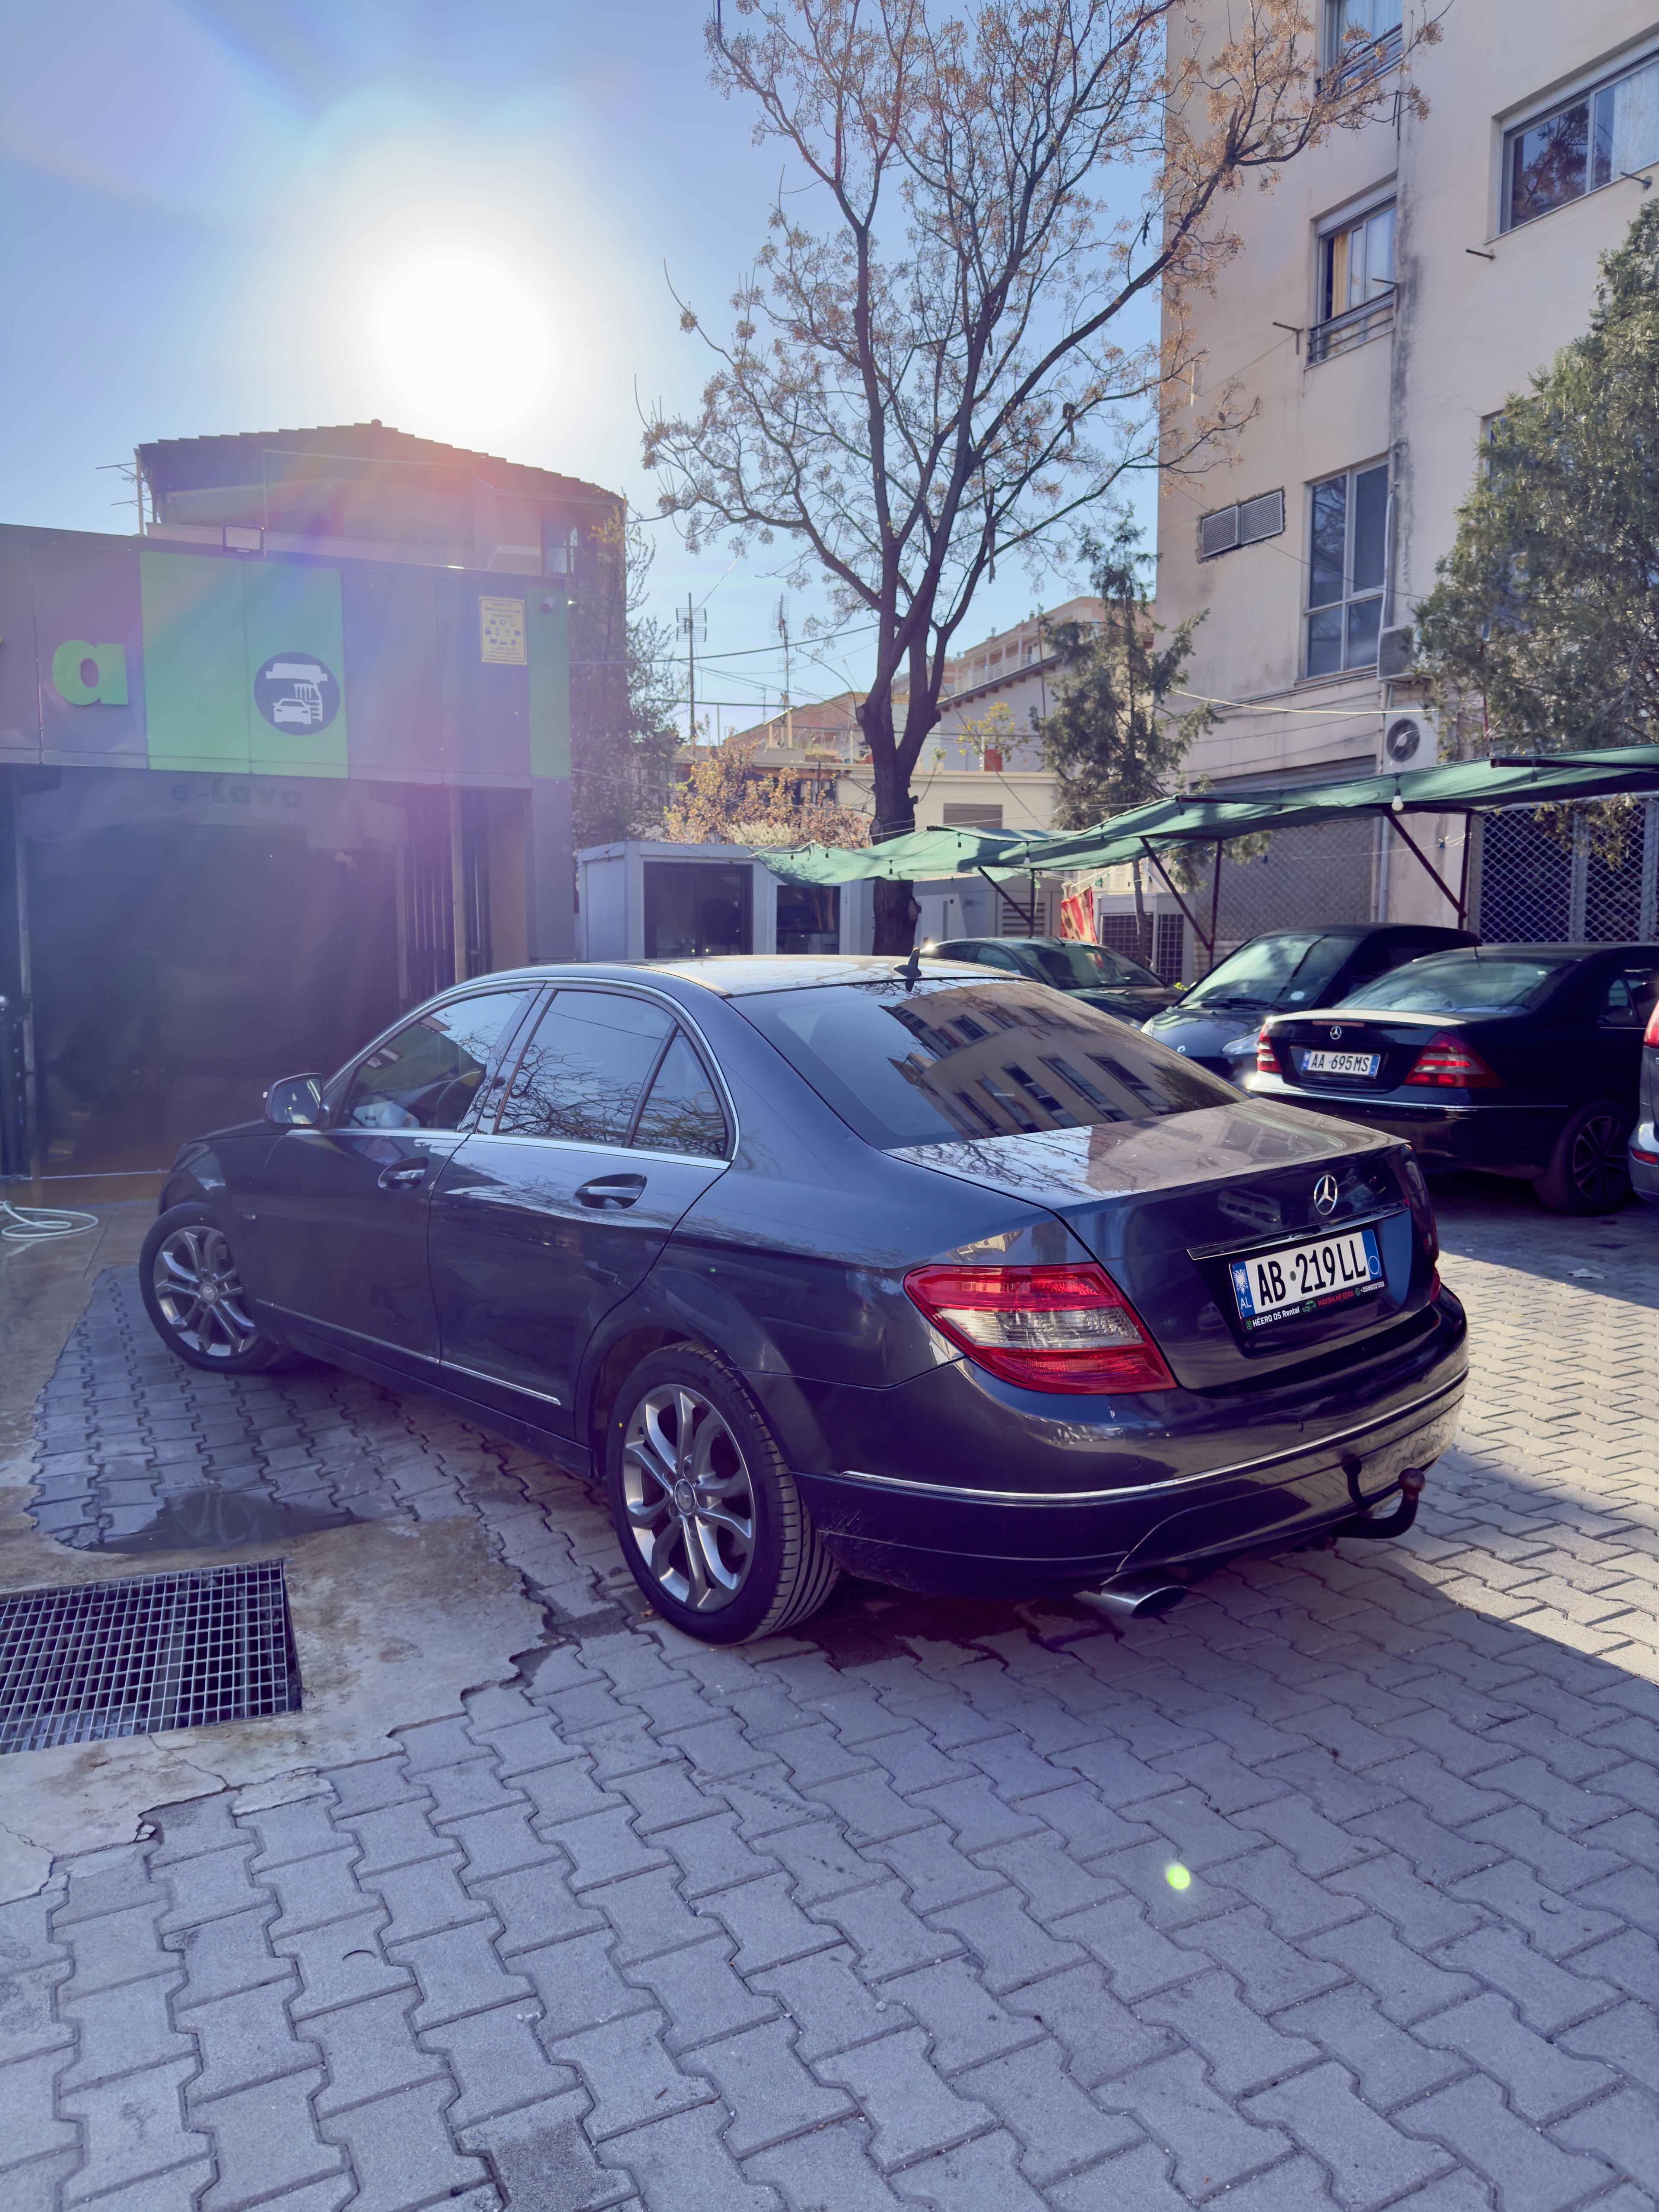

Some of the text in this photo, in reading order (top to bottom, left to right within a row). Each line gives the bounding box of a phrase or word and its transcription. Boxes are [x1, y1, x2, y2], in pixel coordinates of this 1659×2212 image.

[1311, 1053, 1370, 1072] AA 695MS
[1257, 1240, 1366, 1306] AB 219LL
[1241, 1297, 1252, 1309] AL
[1282, 1306, 1300, 1318] Rental
